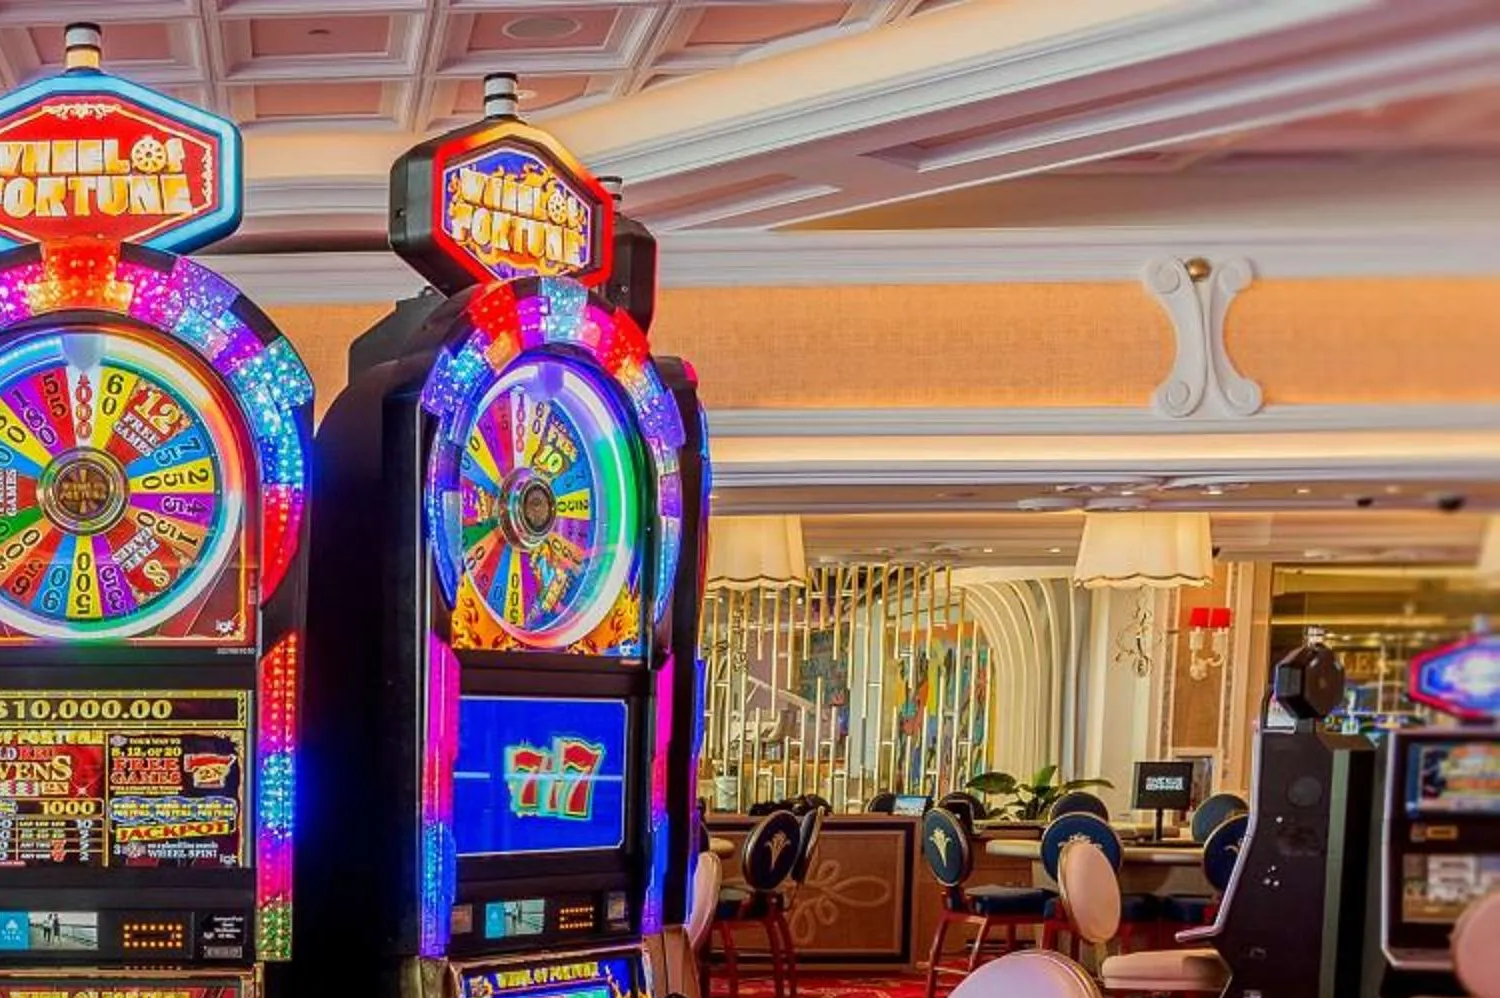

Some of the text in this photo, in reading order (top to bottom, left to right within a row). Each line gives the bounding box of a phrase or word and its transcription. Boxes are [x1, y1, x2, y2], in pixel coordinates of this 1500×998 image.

[457, 166, 547, 222] WHEEL
[449, 203, 584, 267] FORTUNE
[102, 374, 124, 415] 60
[134, 391, 180, 435] 12
[154, 437, 201, 467] 75
[142, 468, 210, 490] 250
[137, 512, 198, 546] 150
[75, 552, 92, 615] 500
[110, 770, 182, 785] GAMES
[112, 757, 180, 771] FREE
[39, 800, 96, 816] 1000
